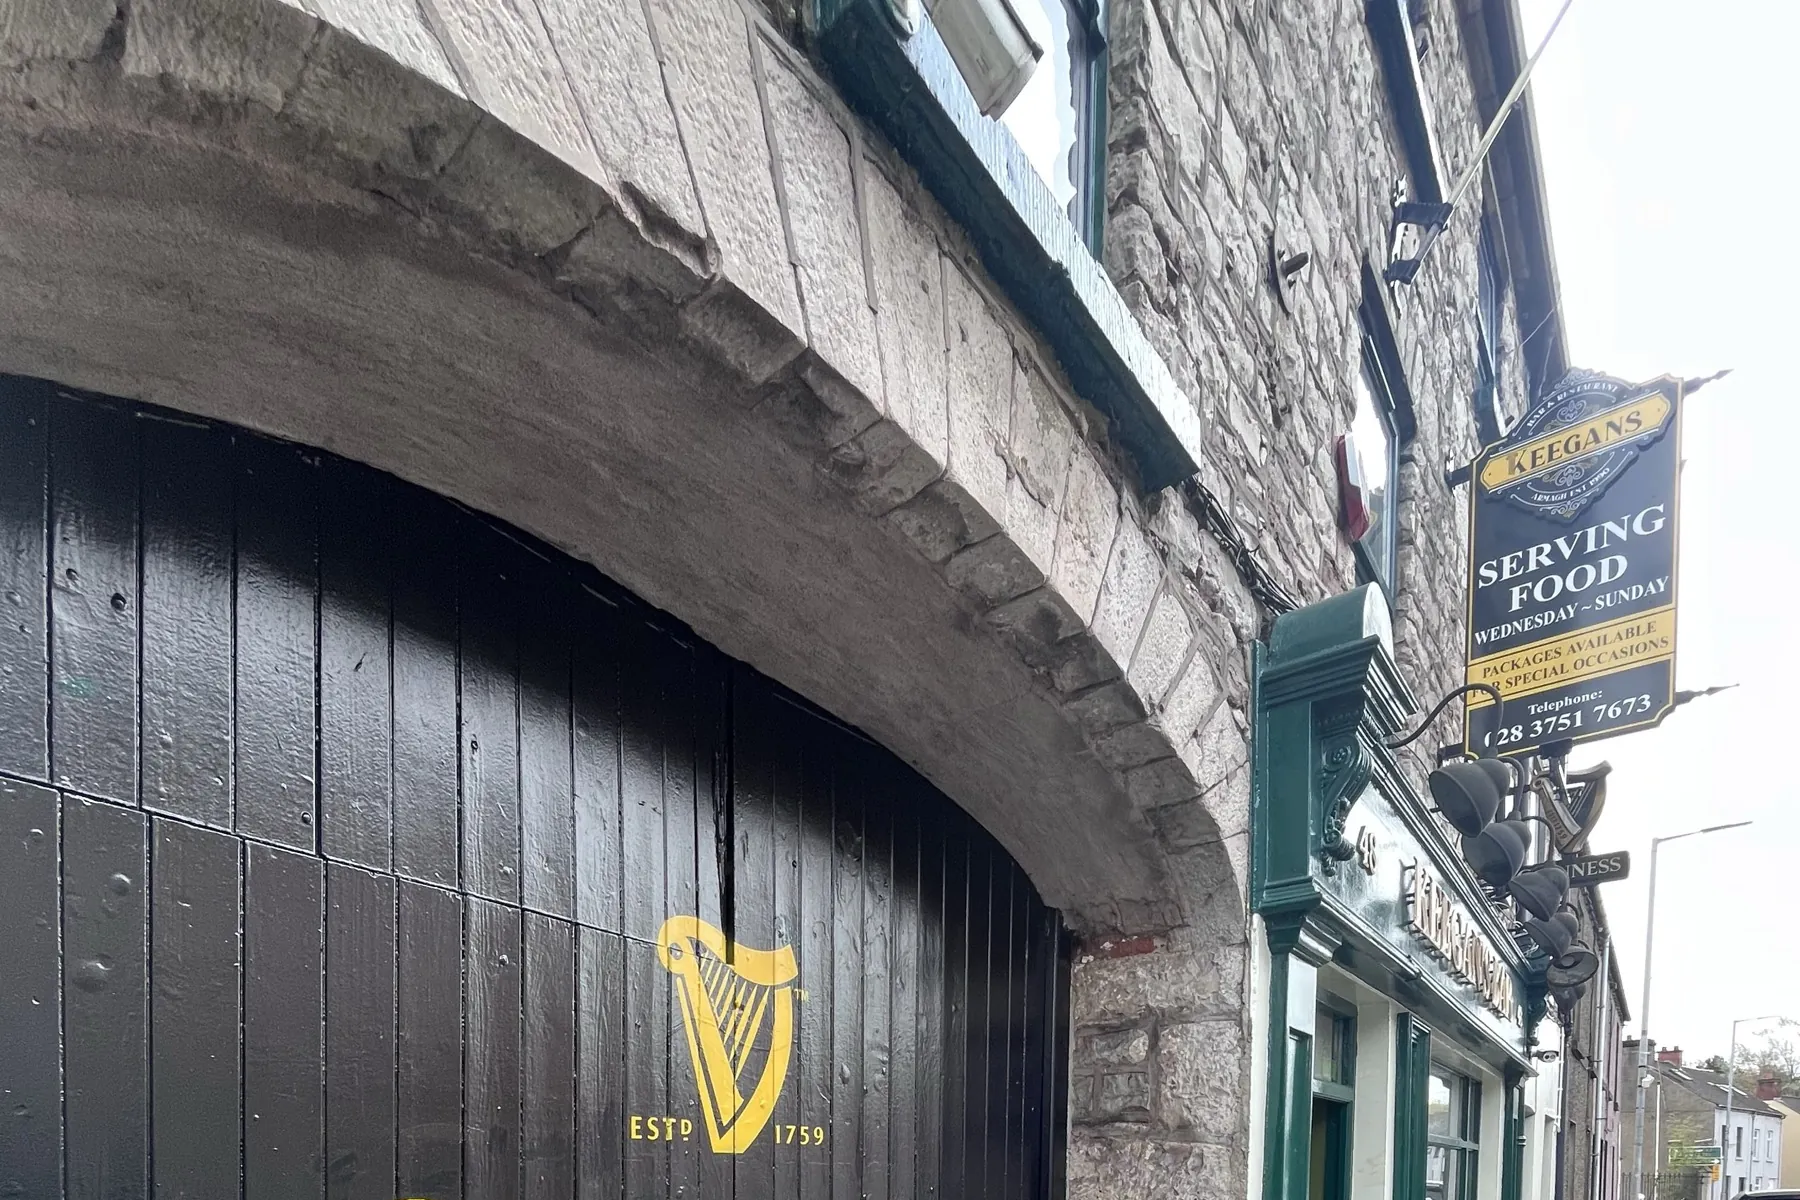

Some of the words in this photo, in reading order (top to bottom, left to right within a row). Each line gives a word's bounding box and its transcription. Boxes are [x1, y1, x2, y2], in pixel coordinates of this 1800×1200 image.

[1505, 410, 1643, 476] KEEGANS
[1531, 492, 1567, 502] ARMAGH
[1478, 503, 1666, 589] SERVING
[1474, 602, 1579, 646] WEDNESDAY
[1594, 575, 1670, 611] SUNDAY
[1508, 554, 1629, 613] FOOD
[1482, 647, 1563, 679] PACKAGES
[1566, 620, 1657, 656] AVAILABLE
[1504, 663, 1570, 690] SPECIAL
[1573, 635, 1670, 671] OCCASIONS
[1527, 690, 1603, 716] Telephone:
[1529, 710, 1583, 738] 3751
[1593, 694, 1652, 723] 7673
[630, 1115, 693, 1142] ESTD
[774, 1123, 824, 1146] 1759
